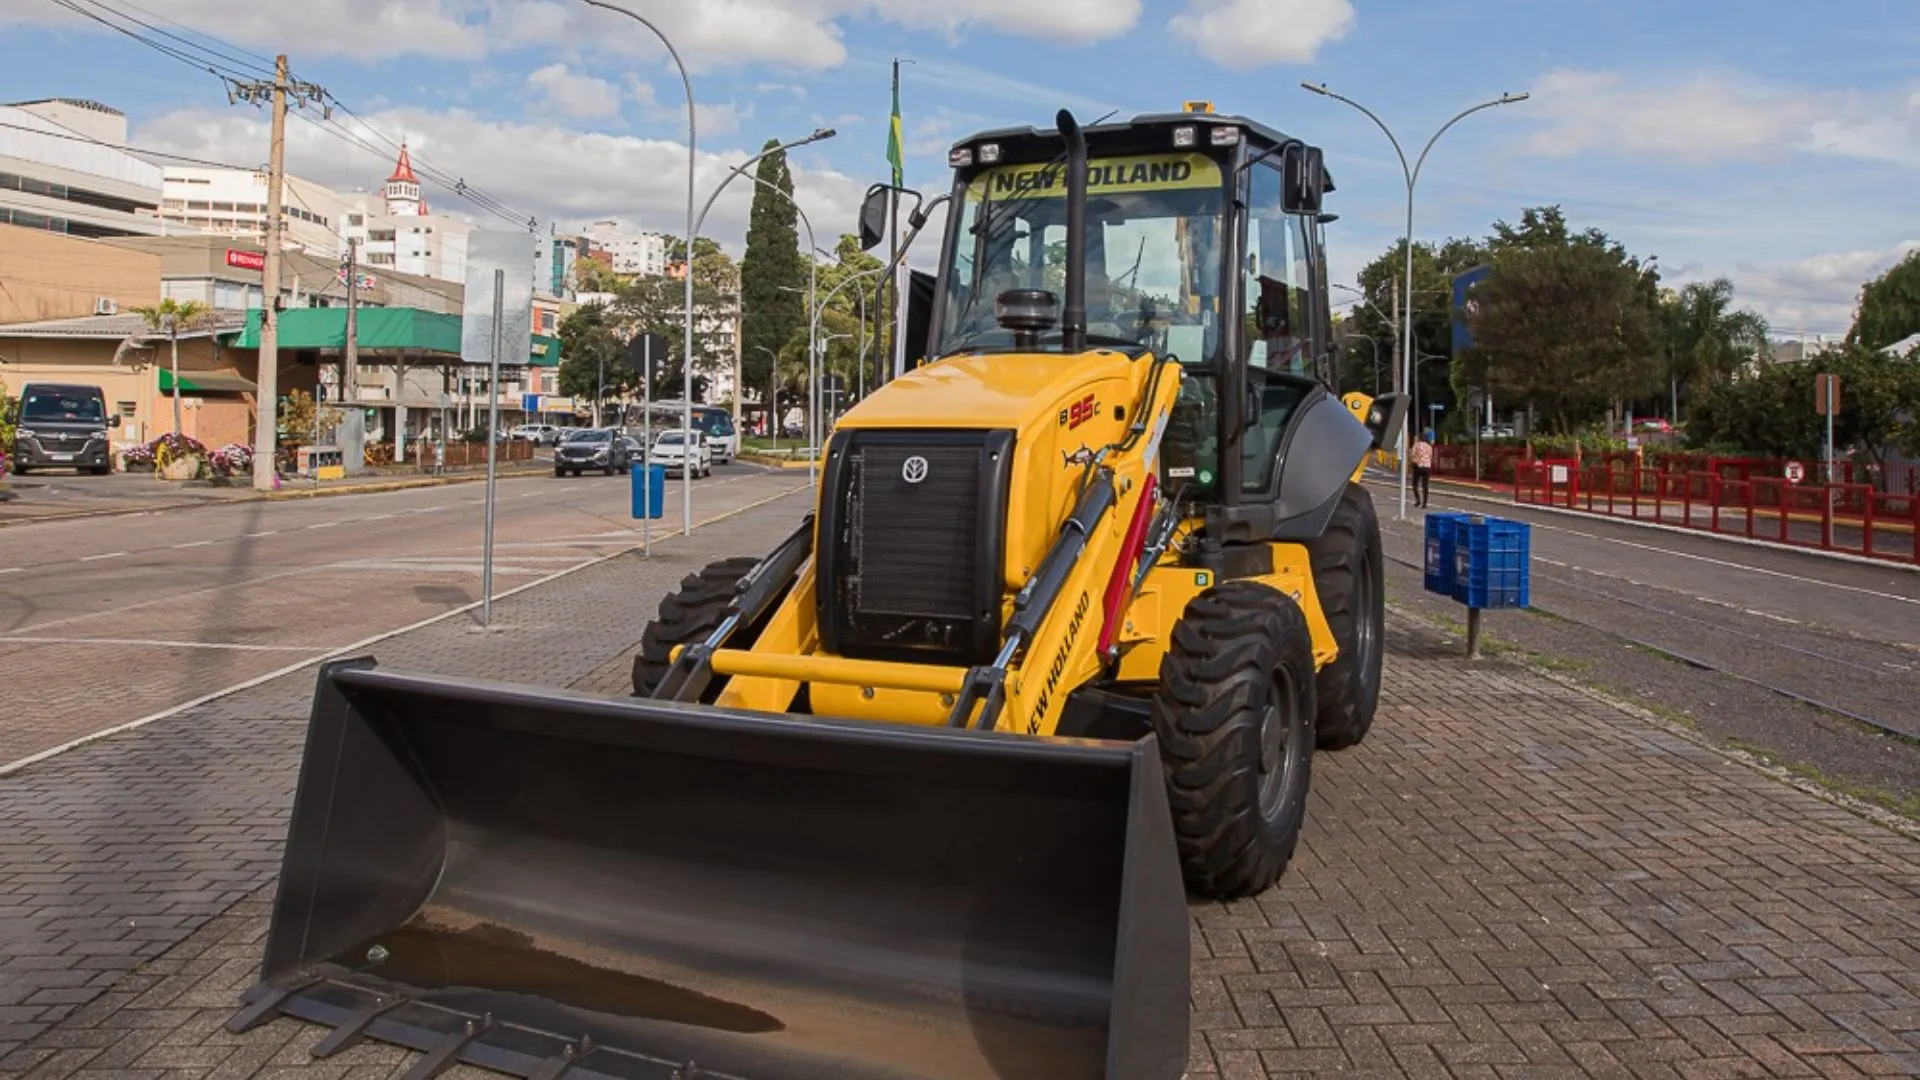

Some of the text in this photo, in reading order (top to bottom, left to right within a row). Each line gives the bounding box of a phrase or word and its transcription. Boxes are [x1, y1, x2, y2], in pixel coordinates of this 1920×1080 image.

[996, 160, 1191, 193] NEW OLLAND
[1047, 590, 1089, 695] HOLLAND
